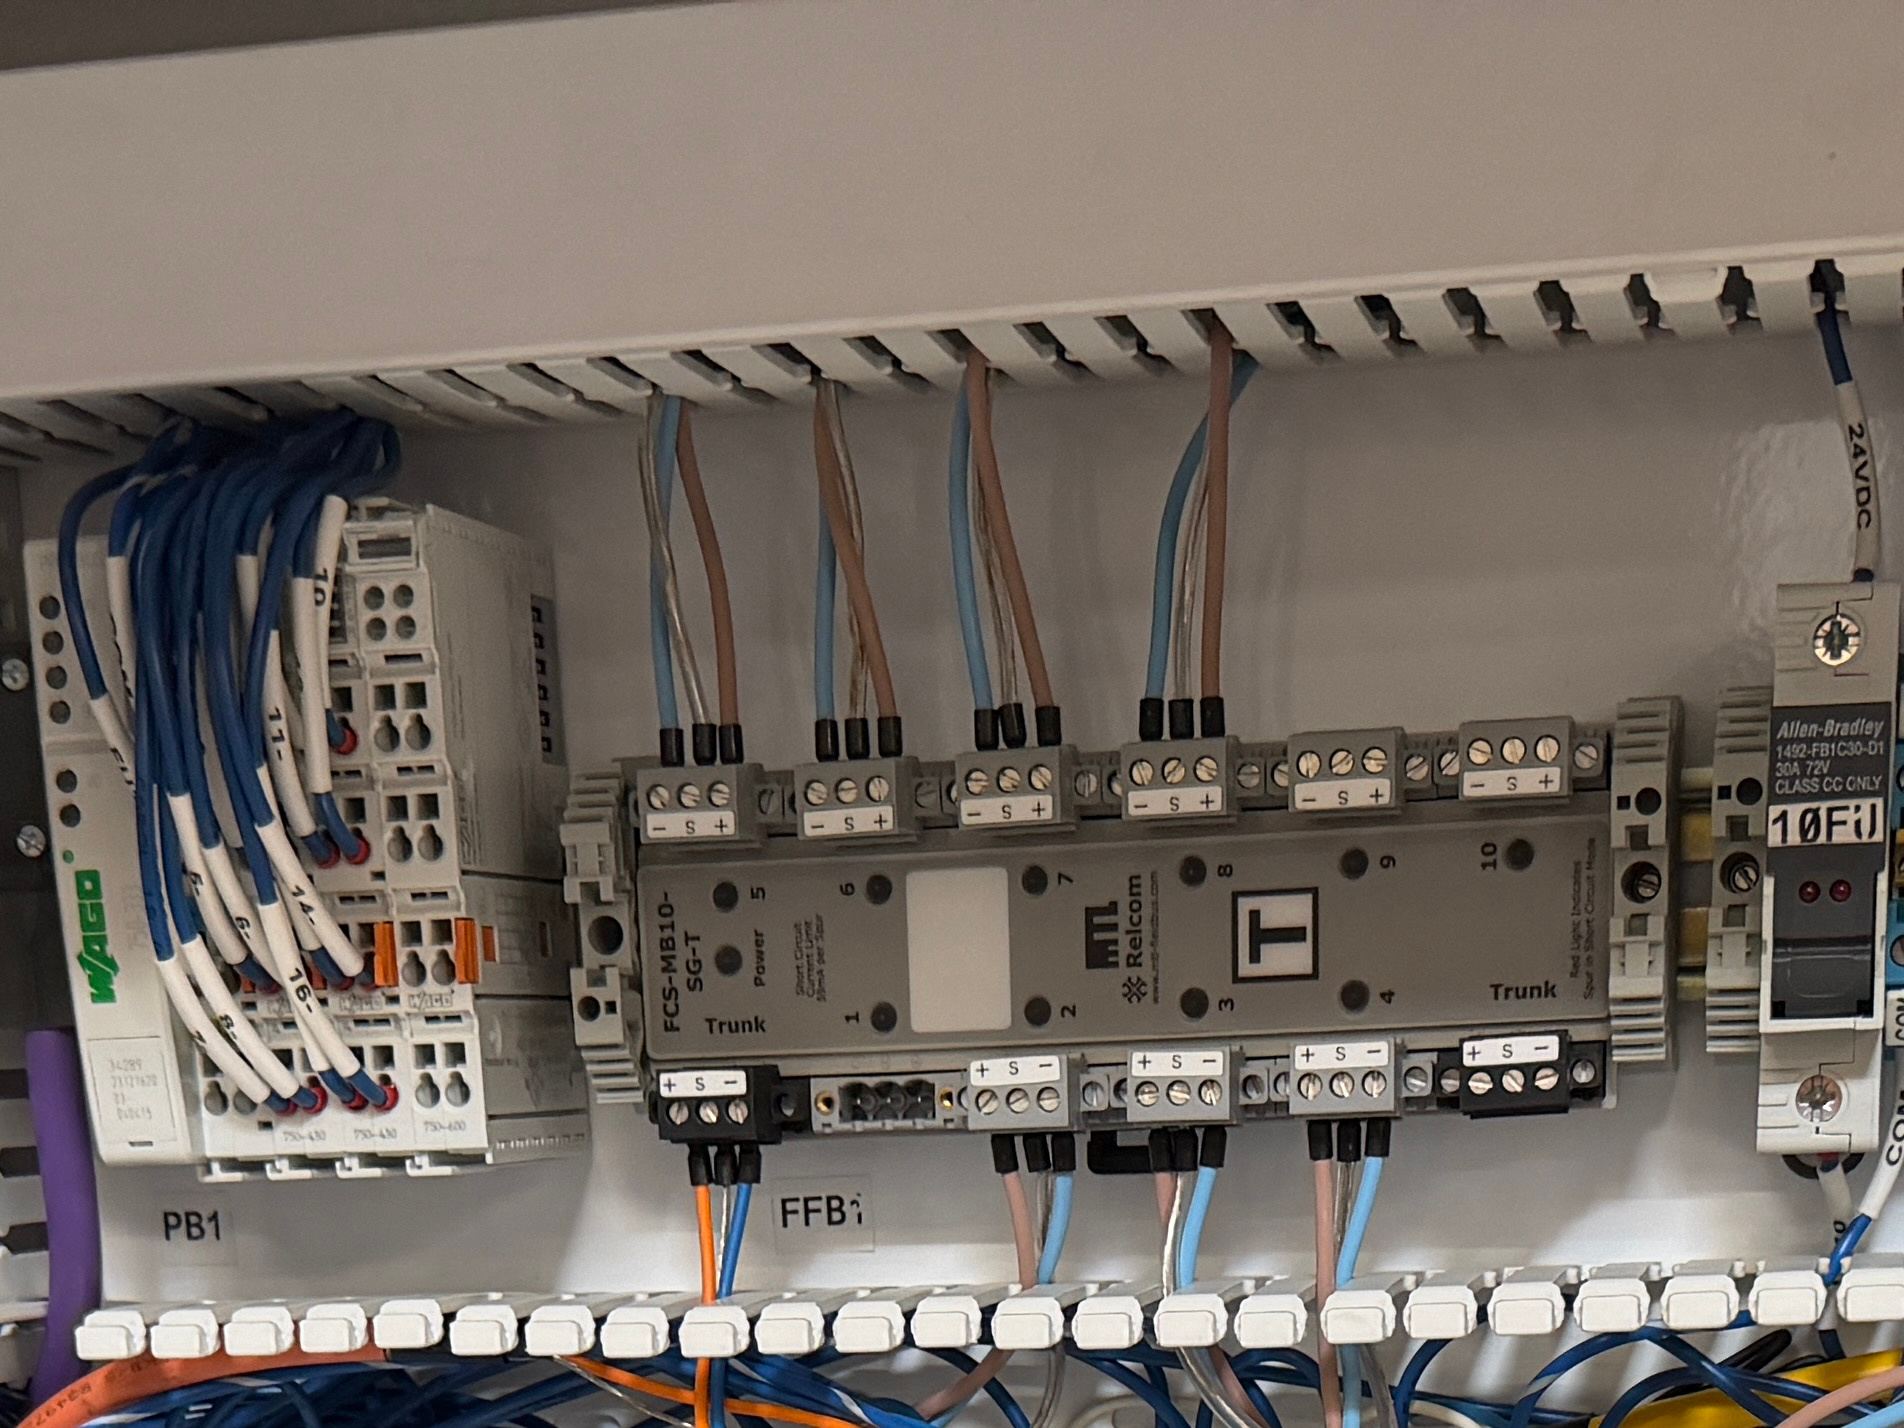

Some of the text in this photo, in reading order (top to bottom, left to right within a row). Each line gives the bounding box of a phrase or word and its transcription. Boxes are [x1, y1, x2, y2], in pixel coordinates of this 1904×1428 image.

[1847, 423, 1871, 530] 24VDC
[1777, 719, 1884, 739] Allen-Bradley
[1775, 760, 1830, 776] 30A 72V
[1775, 778, 1818, 795] CLASS
[1846, 776, 1882, 791] ONLY
[1480, 843, 1498, 870] 10
[1058, 872, 1074, 885] 7
[1218, 864, 1233, 878] 8
[751, 887, 765, 900] 5
[839, 883, 855, 896] 6
[1125, 875, 1142, 967] Relcom
[76, 869, 120, 1003] WAGO
[658, 892, 680, 1032] FCS-MB10-
[685, 931, 703, 992] SG-T
[754, 930, 766, 987] Power
[1490, 981, 1558, 1002] Trunk
[704, 1015, 766, 1035] Trunk
[163, 1211, 221, 1241] PB1
